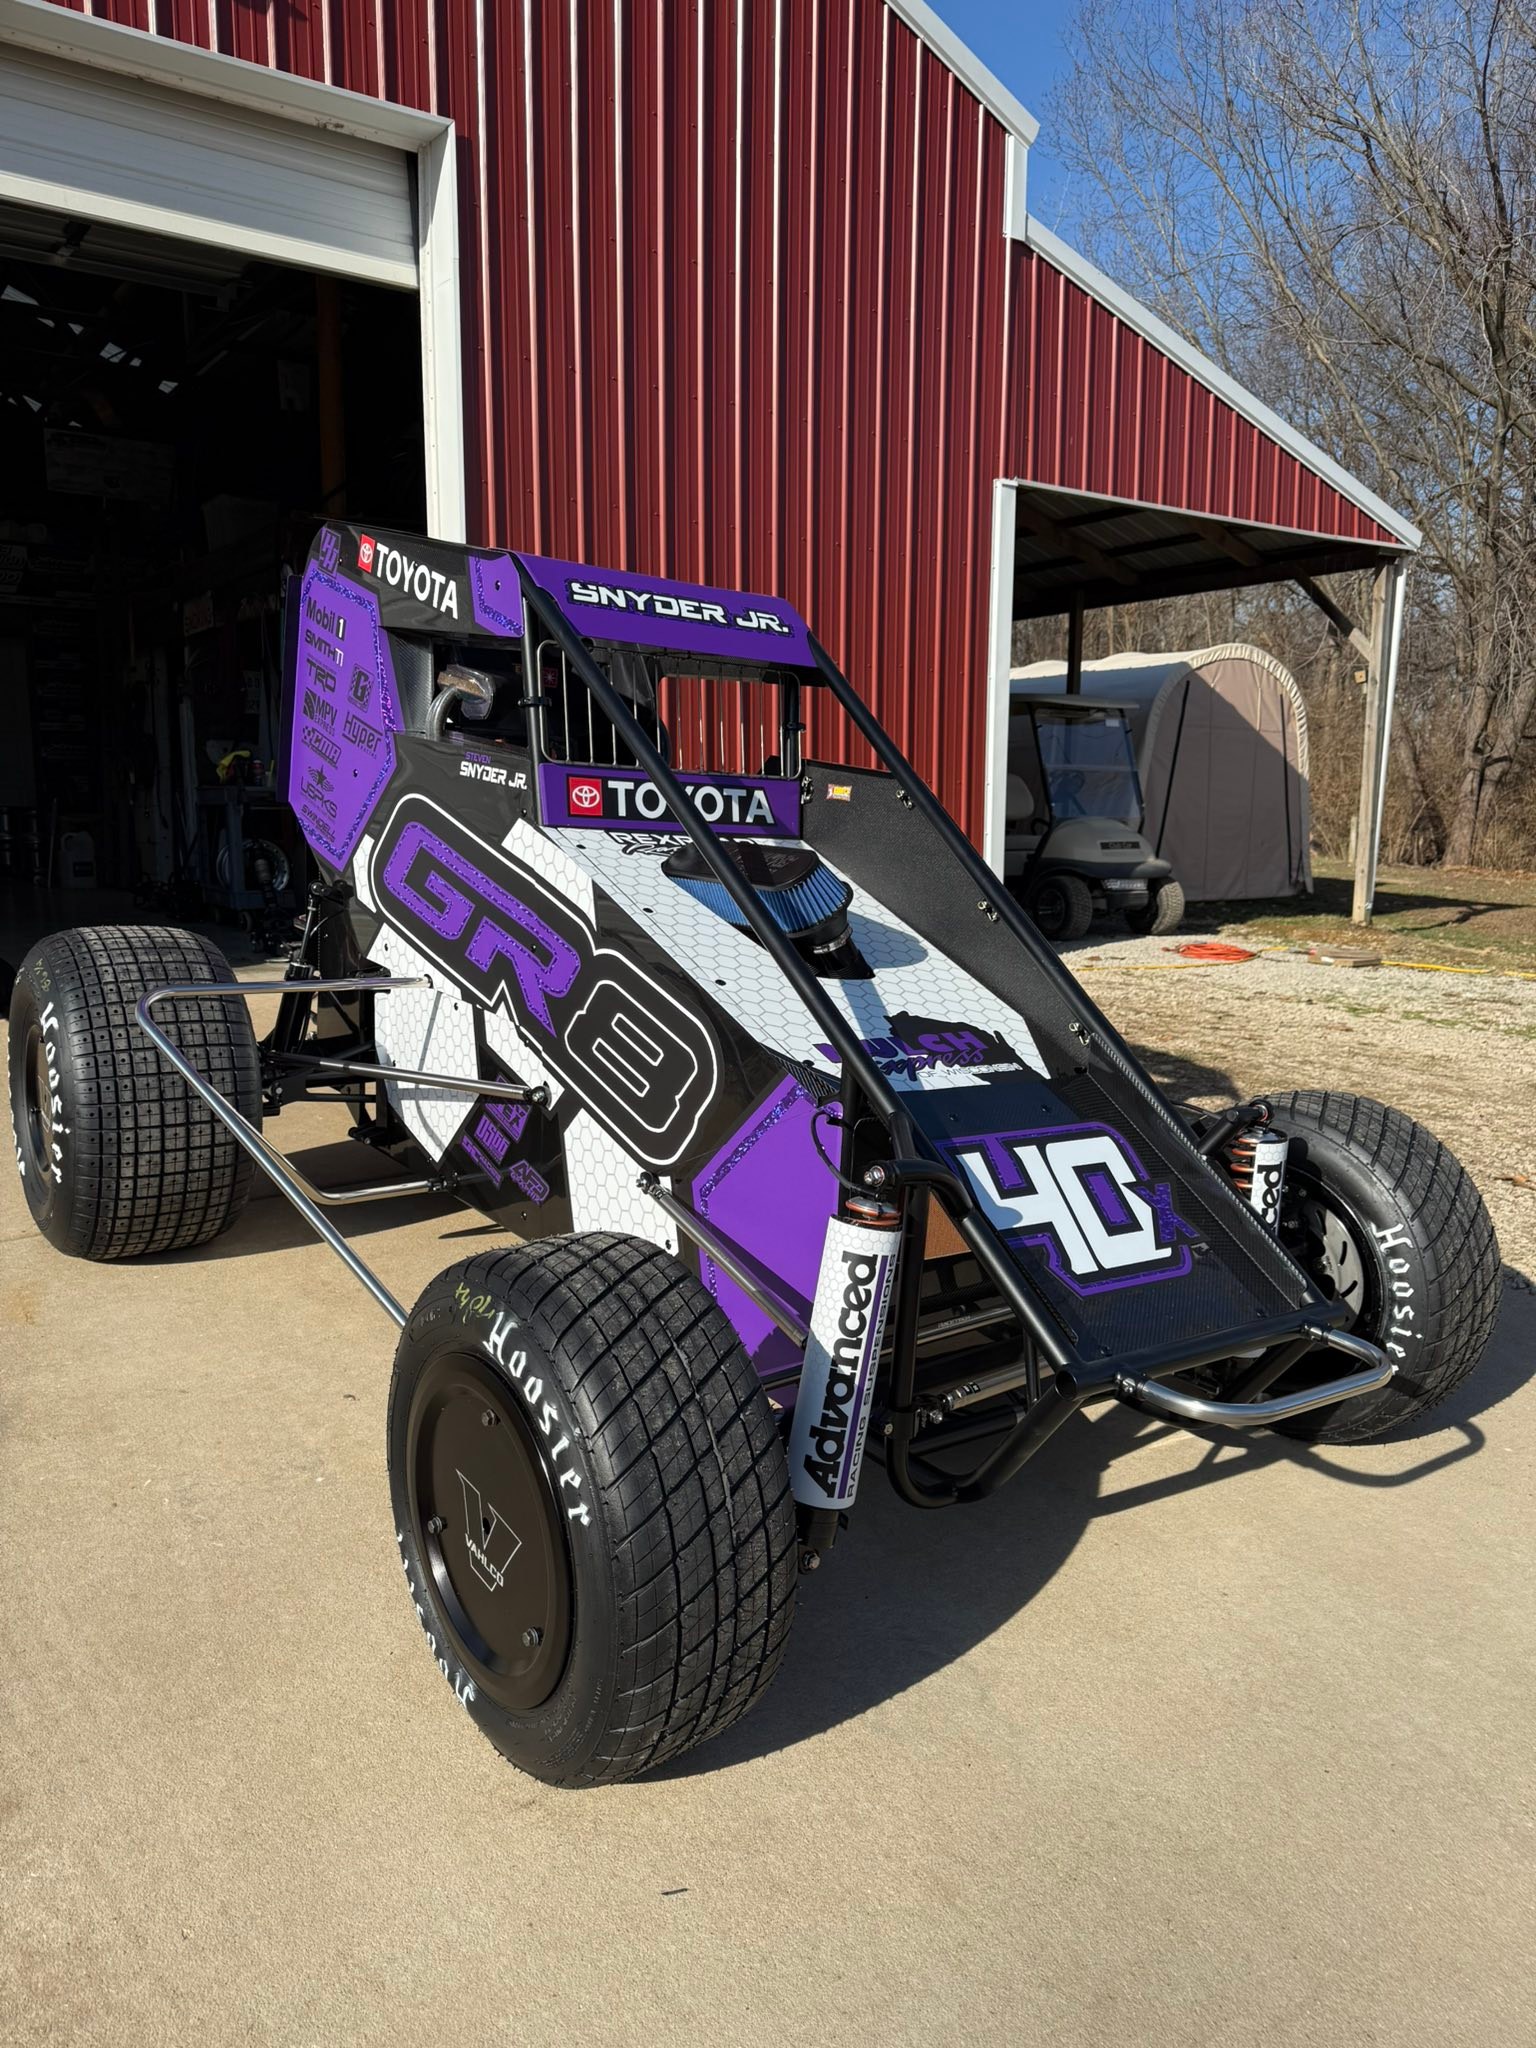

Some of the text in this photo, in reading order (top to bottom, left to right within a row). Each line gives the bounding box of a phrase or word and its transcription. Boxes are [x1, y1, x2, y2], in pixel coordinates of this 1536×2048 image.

[376, 542, 458, 620] TOYOTA
[305, 596, 335, 635] Mobil
[571, 582, 789, 633] SNYDER JR.
[306, 658, 337, 693] TRD
[315, 696, 338, 726] MPV
[342, 711, 382, 752] Hyper
[459, 760, 507, 785] SNYDER
[464, 751, 491, 764] STEVEN
[607, 780, 775, 824] TOOTA
[381, 819, 702, 1136] GR8
[39, 1002, 71, 1184] Hoosier
[802, 1250, 878, 1499] Advanced
[847, 1253, 896, 1498] RACING SUSPENSIONS
[482, 1311, 592, 1527] Hoosier
[464, 1532, 504, 1588] VAHLCO
